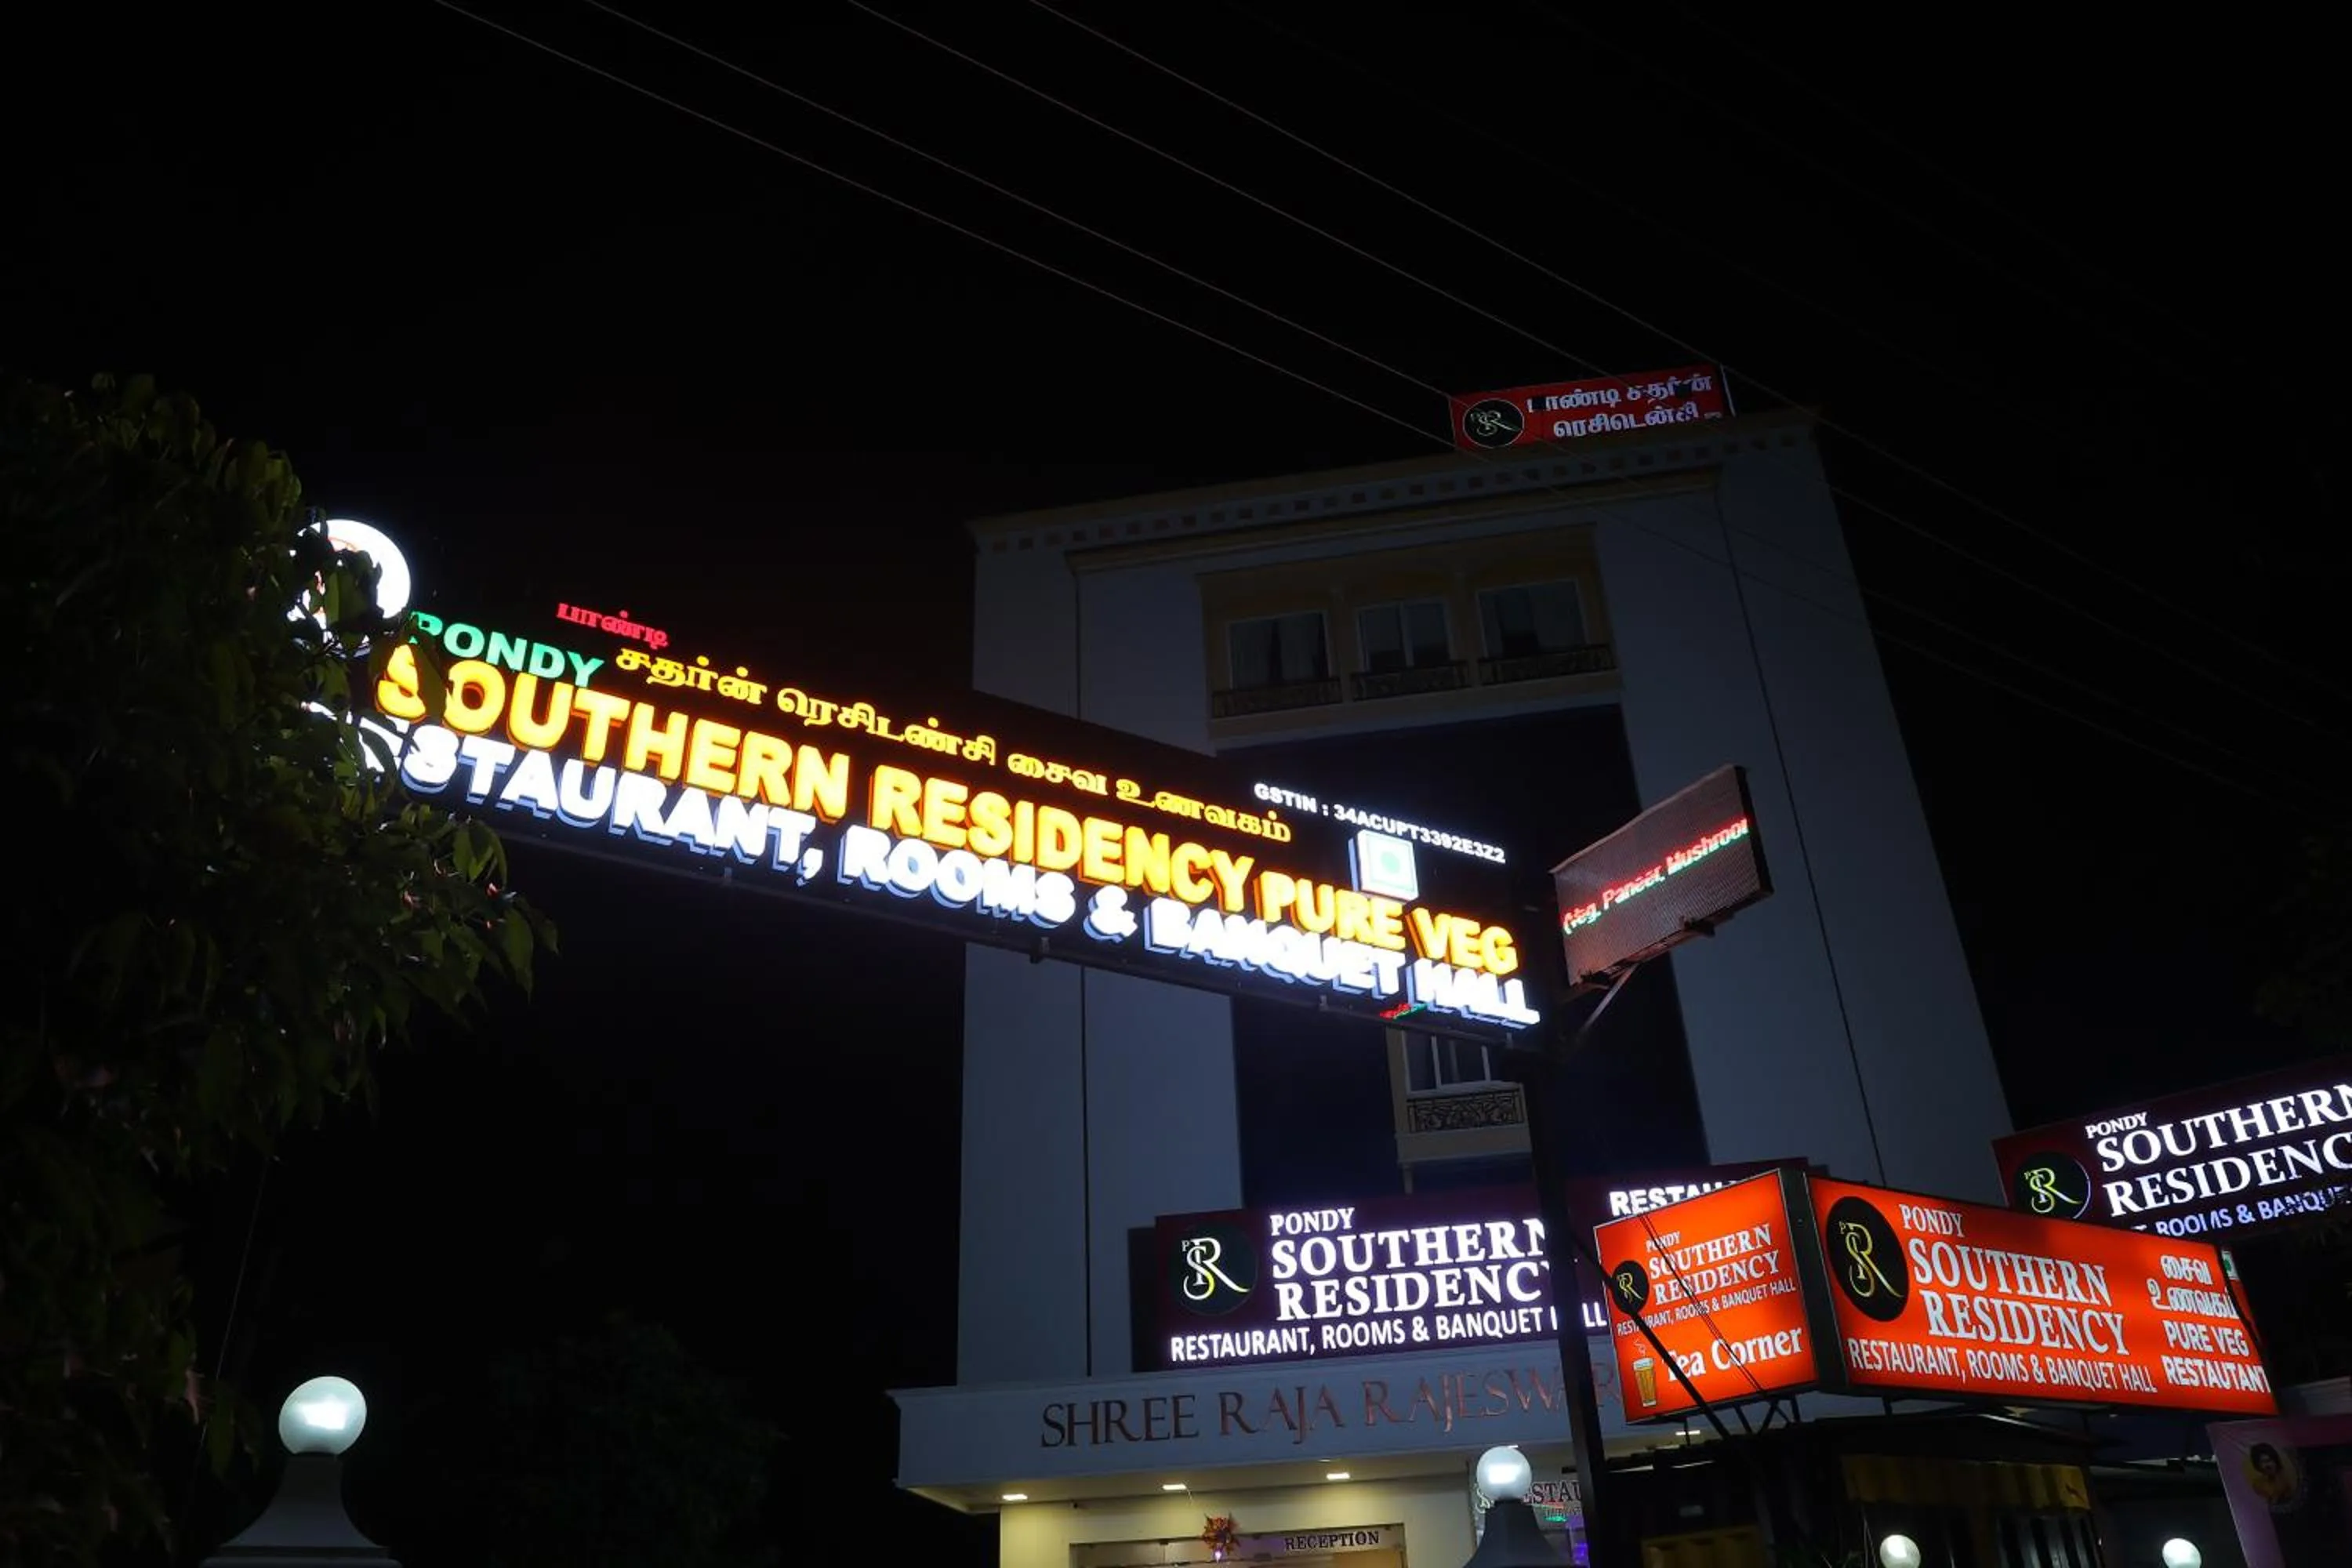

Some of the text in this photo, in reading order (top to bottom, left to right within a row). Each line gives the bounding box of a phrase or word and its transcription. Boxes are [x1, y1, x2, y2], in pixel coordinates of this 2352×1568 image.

[556, 602, 669, 648] பாண்டி
[376, 644, 1519, 977] SOUTHERN RESIDENCY PURE VEG
[1007, 753, 1108, 797] சைவ
[1116, 779, 1291, 844] உணவகம்
[1254, 782, 1317, 814] GSTIN
[837, 824, 1076, 929] ROOMS
[1083, 886, 1138, 942] &
[1144, 897, 1406, 1000] BANQUET
[1406, 957, 1541, 1029] HALL
[2085, 1111, 2148, 1140] PONDY
[1269, 1207, 1355, 1236] PONDY
[1898, 1203, 1965, 1238] PONDY
[2235, 1203, 2256, 1224] &
[1648, 1225, 1773, 1279] SOUTHERN
[1908, 1238, 2112, 1307] SOUTHERN
[1275, 1260, 1550, 1322] RESIDENC
[1711, 1298, 1721, 1312] &
[1722, 1283, 1768, 1309] BANQUET
[1769, 1277, 1796, 1295] HALL
[1171, 1326, 1315, 1362] RESTAURANT,
[1323, 1318, 1406, 1348] ROOMS
[1414, 1316, 1432, 1341] &
[1438, 1307, 1543, 1341] BANQUET
[1918, 1289, 2130, 1356] RESIDENCY
[2161, 1319, 2250, 1357] PURE VEG
[1711, 1327, 1802, 1371] Corner
[1848, 1336, 2158, 1393] RESTAURANT, ROOMS & BANQUET HALL
[2161, 1354, 2271, 1393] RESTAUTANT
[1041, 1395, 1200, 1448] SHREE
[1219, 1383, 1345, 1445] RAJA
[1284, 1530, 1380, 1551] RECEPTION
